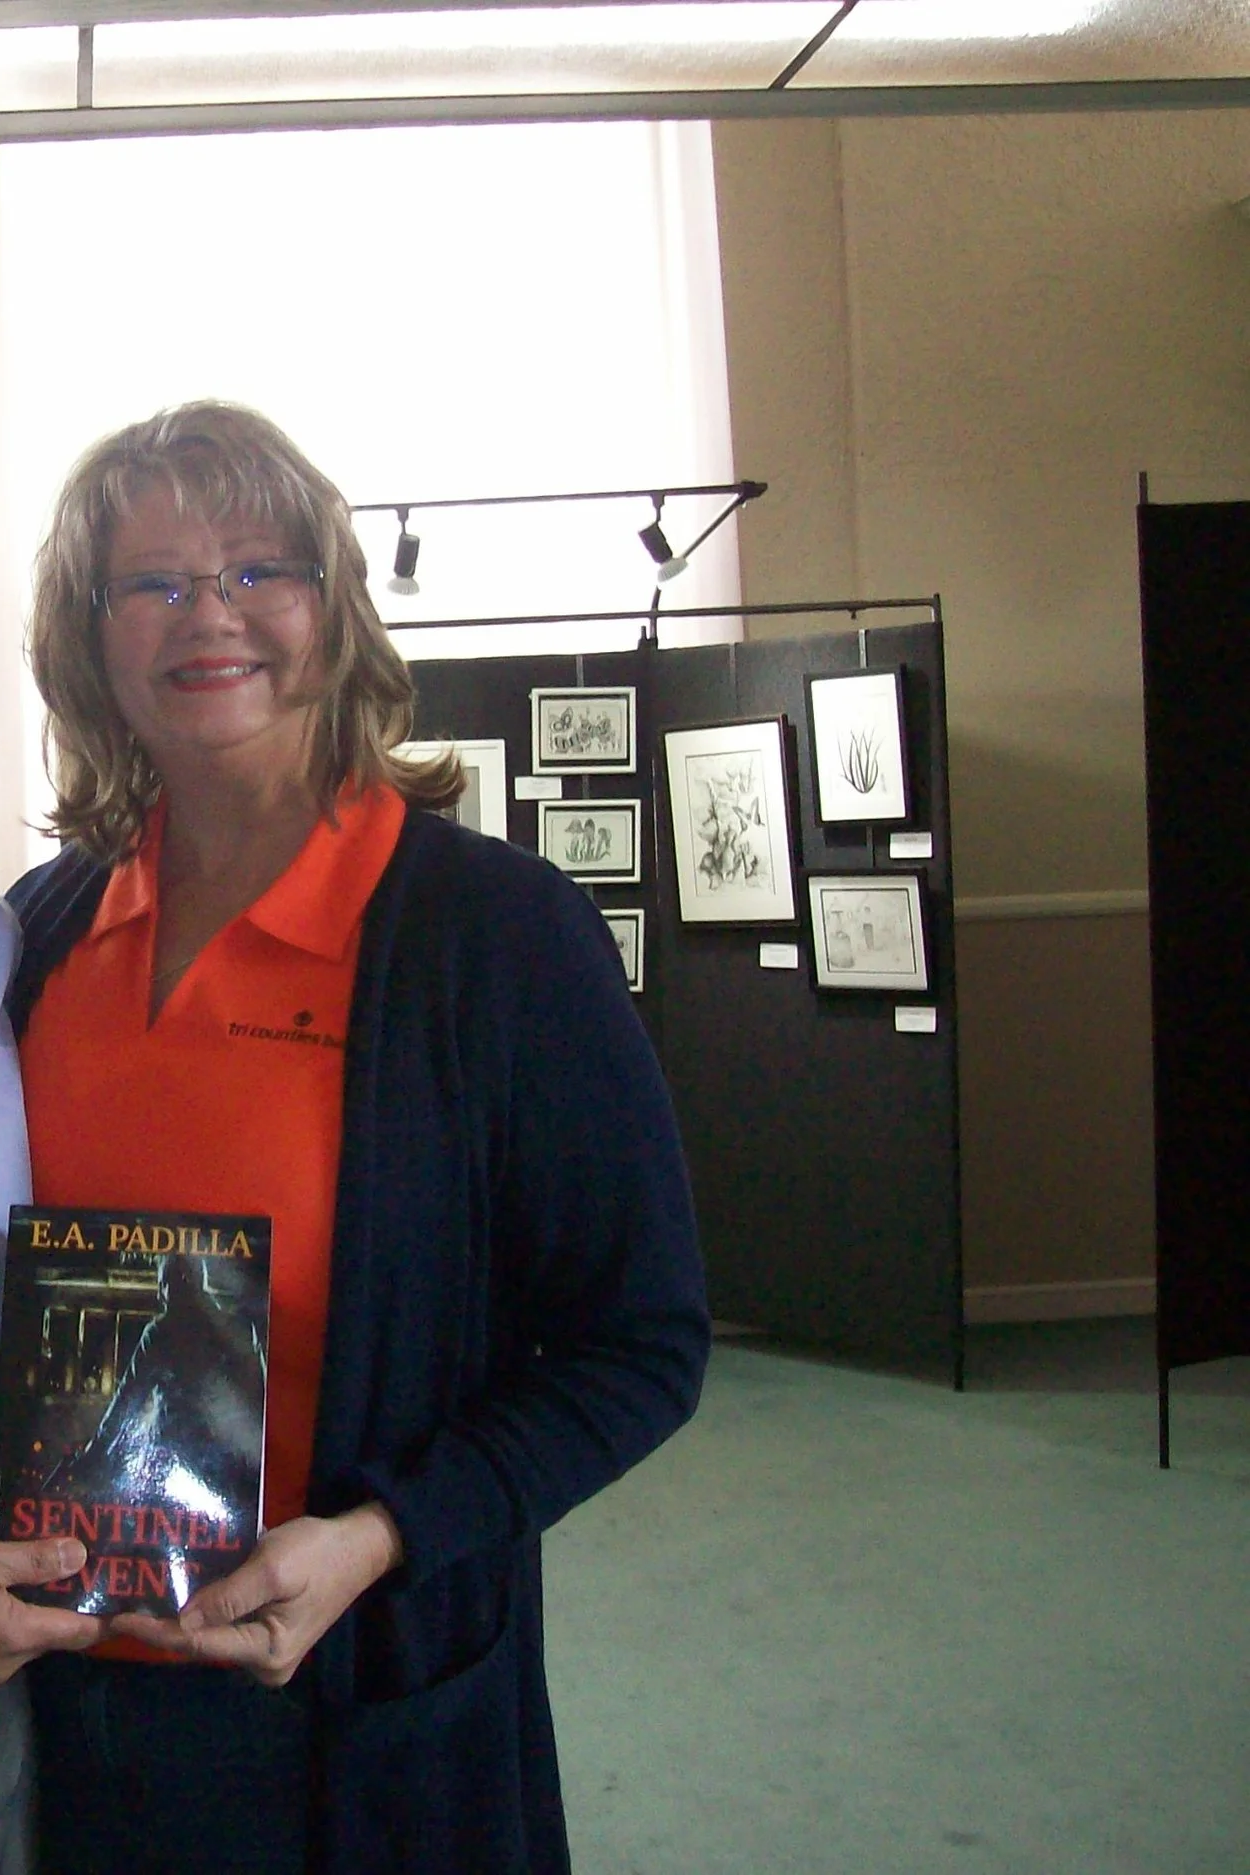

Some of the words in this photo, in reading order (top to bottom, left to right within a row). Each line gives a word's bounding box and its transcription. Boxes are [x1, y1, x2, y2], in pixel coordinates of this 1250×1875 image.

[31, 1219, 95, 1251] E.A.
[108, 1223, 254, 1259] PADILLA
[11, 1498, 241, 1552] SENTINEL
[45, 1556, 205, 1599] VEN
